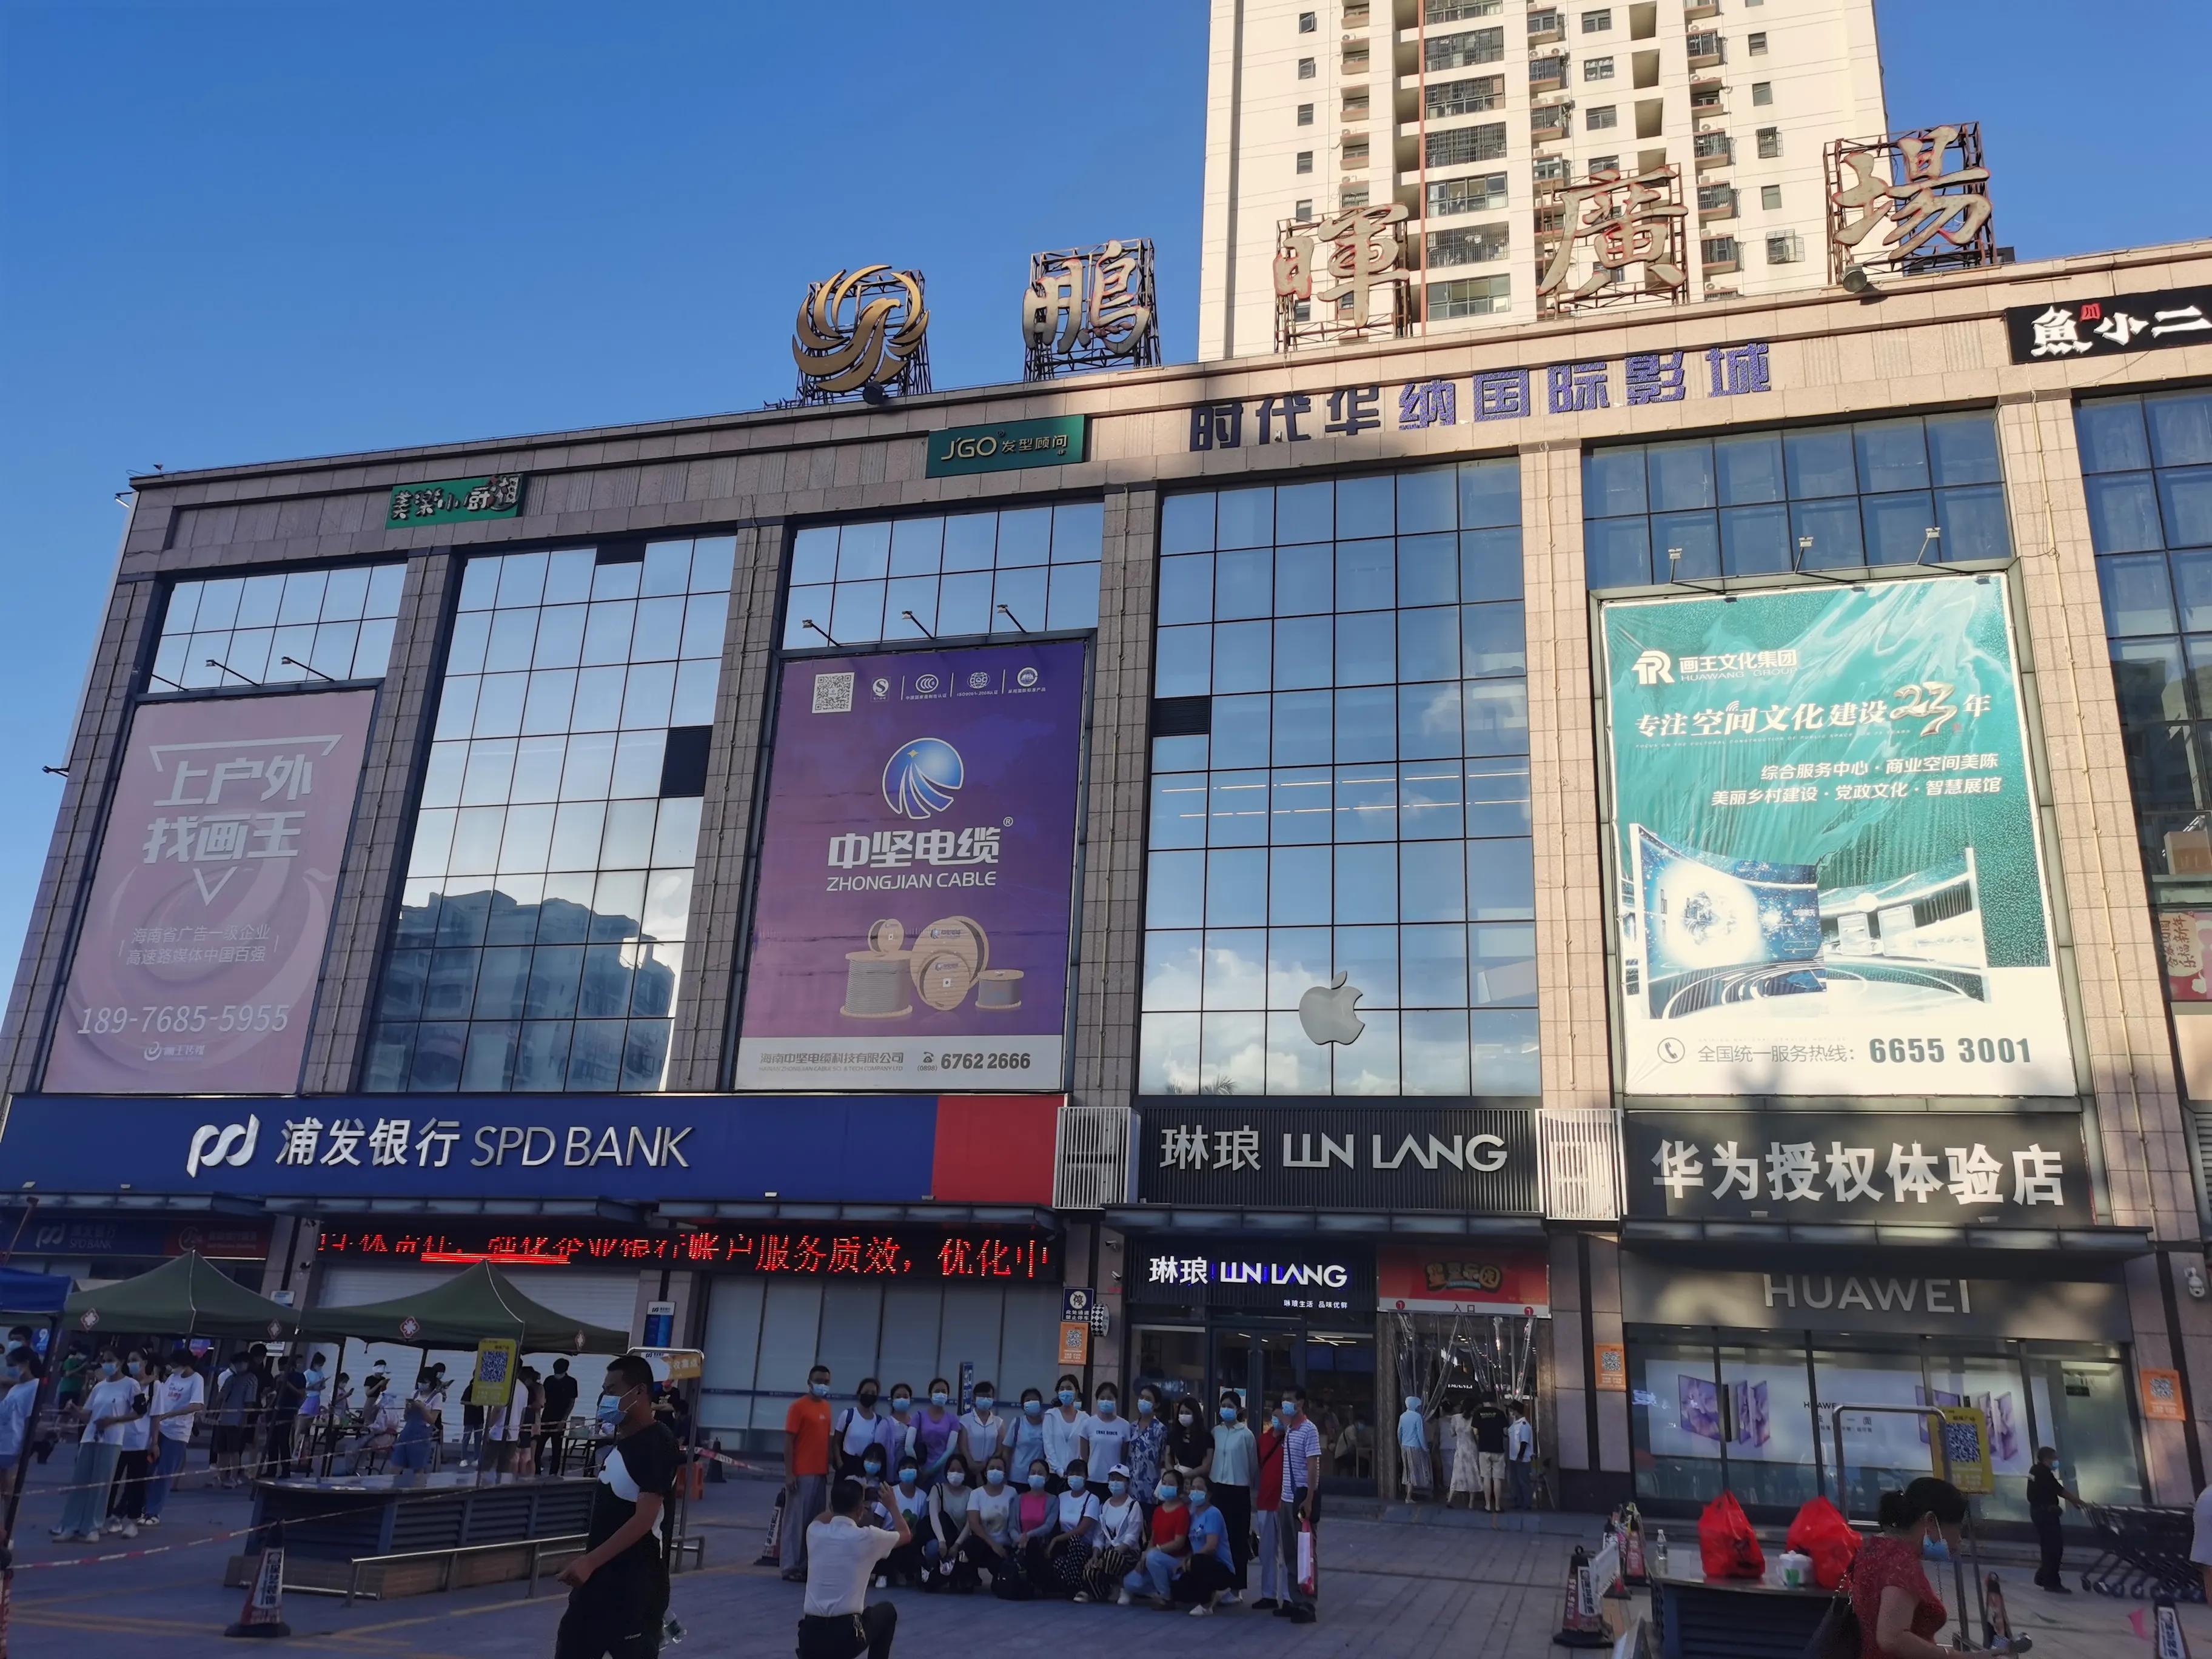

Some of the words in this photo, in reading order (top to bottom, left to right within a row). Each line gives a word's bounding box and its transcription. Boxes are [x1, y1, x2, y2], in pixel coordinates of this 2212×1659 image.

[1188, 343, 1770, 452] 时代华纳国际影城
[1002, 434, 1068, 454] 发型顾问
[1679, 649, 1797, 674] 画王文化集团
[1681, 671, 1744, 682] HUAWANG
[1752, 668, 1798, 677] GROUP
[153, 756, 313, 806] 上户外
[142, 811, 307, 865] 找画王
[827, 826, 1000, 869] 中坚电缆
[826, 874, 933, 892] ZHONGJIAN
[936, 871, 996, 887] CABLE
[131, 924, 270, 944] 海南省广告一级企业
[77, 1004, 290, 1035] 189-7685-5955
[760, 1052, 904, 1064] 海南中坚电缆科技有限公司
[941, 1053, 984, 1070] 6762
[987, 1053, 1031, 1069] 2666
[1870, 1038, 1945, 1064] 6655
[1959, 1037, 2031, 1064] 3001
[275, 1117, 461, 1168] 浦发银行
[470, 1126, 557, 1168] SPD
[565, 1126, 693, 1168] BANK
[1160, 1125, 1262, 1171] 琳琅
[1373, 1133, 1507, 1171] LANG
[1652, 1139, 2064, 1206] 华为授权体验店
[1148, 1256, 1208, 1284] 琳琅
[1271, 1263, 1348, 1288] LANG
[1764, 1274, 1971, 1313] HUAWEI
[1453, 1304, 1475, 1313] 入口
